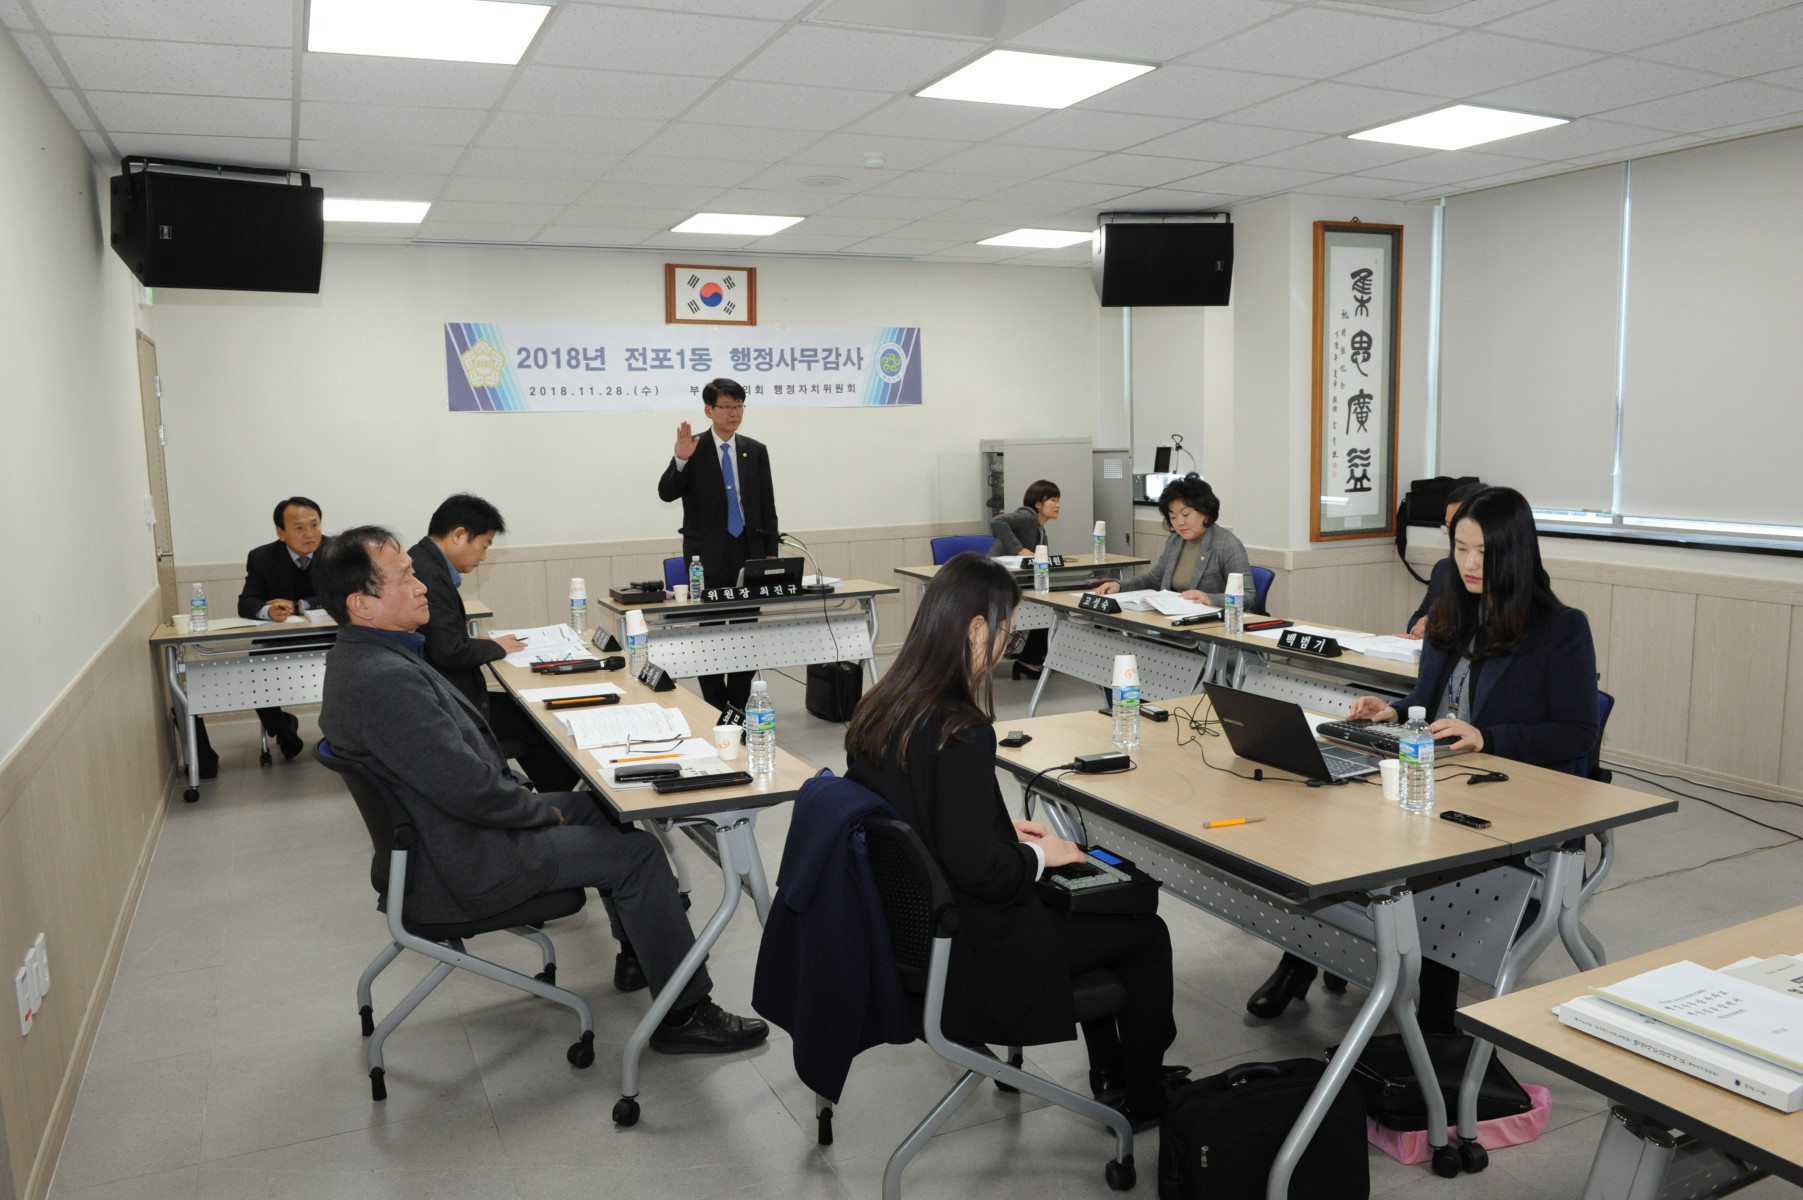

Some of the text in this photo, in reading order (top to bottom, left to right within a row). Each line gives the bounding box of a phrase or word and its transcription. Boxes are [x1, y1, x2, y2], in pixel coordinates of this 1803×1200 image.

[516, 346, 606, 372] 2018년
[624, 346, 713, 373] 전포1동
[729, 346, 864, 372] 행정사무감사
[529, 386, 659, 397] 2018.11.28.(수)
[773, 383, 857, 395] 행정자치위원회
[707, 584, 798, 601] 위원장 최진규
[1285, 632, 1327, 653] 백범기
